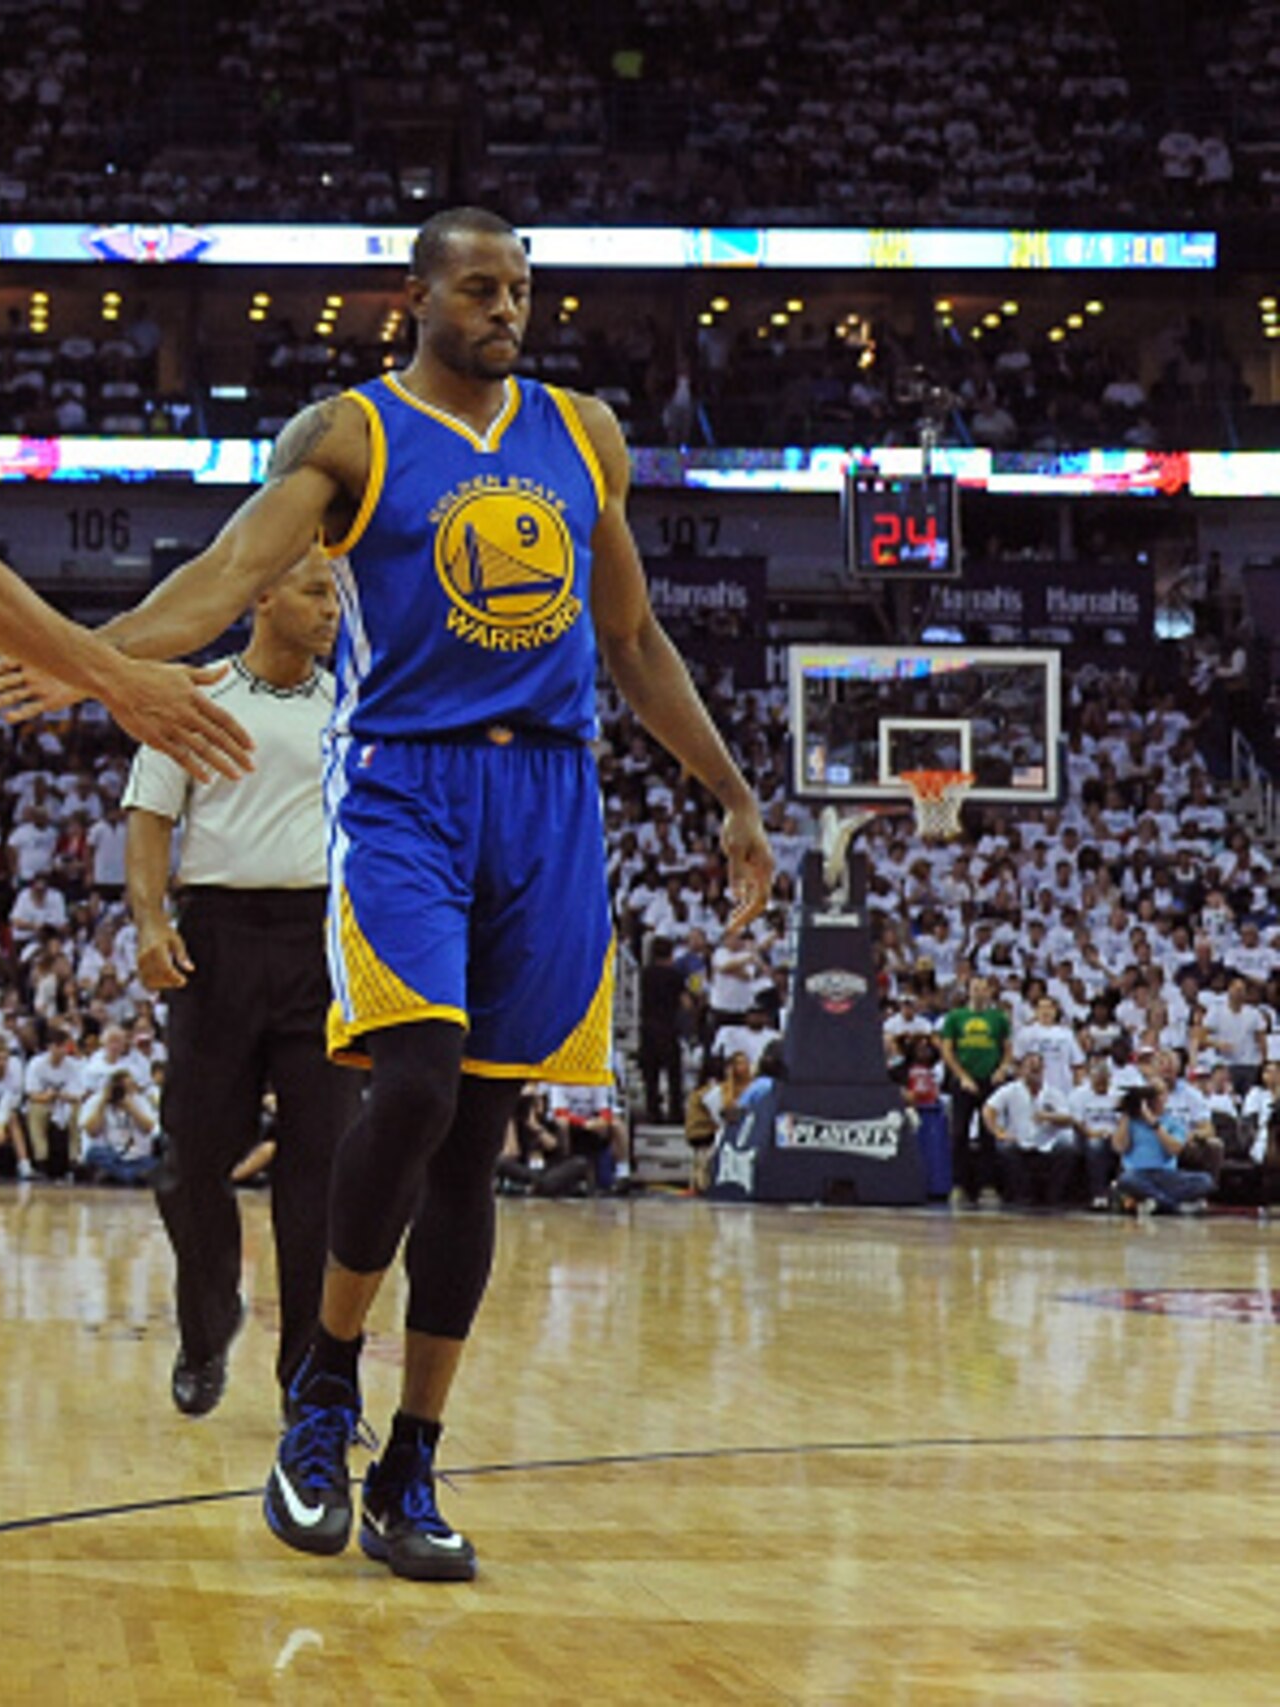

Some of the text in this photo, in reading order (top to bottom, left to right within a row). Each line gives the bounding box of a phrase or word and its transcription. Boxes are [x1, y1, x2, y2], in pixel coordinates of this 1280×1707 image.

[67, 509, 131, 553] 106
[516, 514, 540, 548] 9
[871, 513, 938, 566] 24
